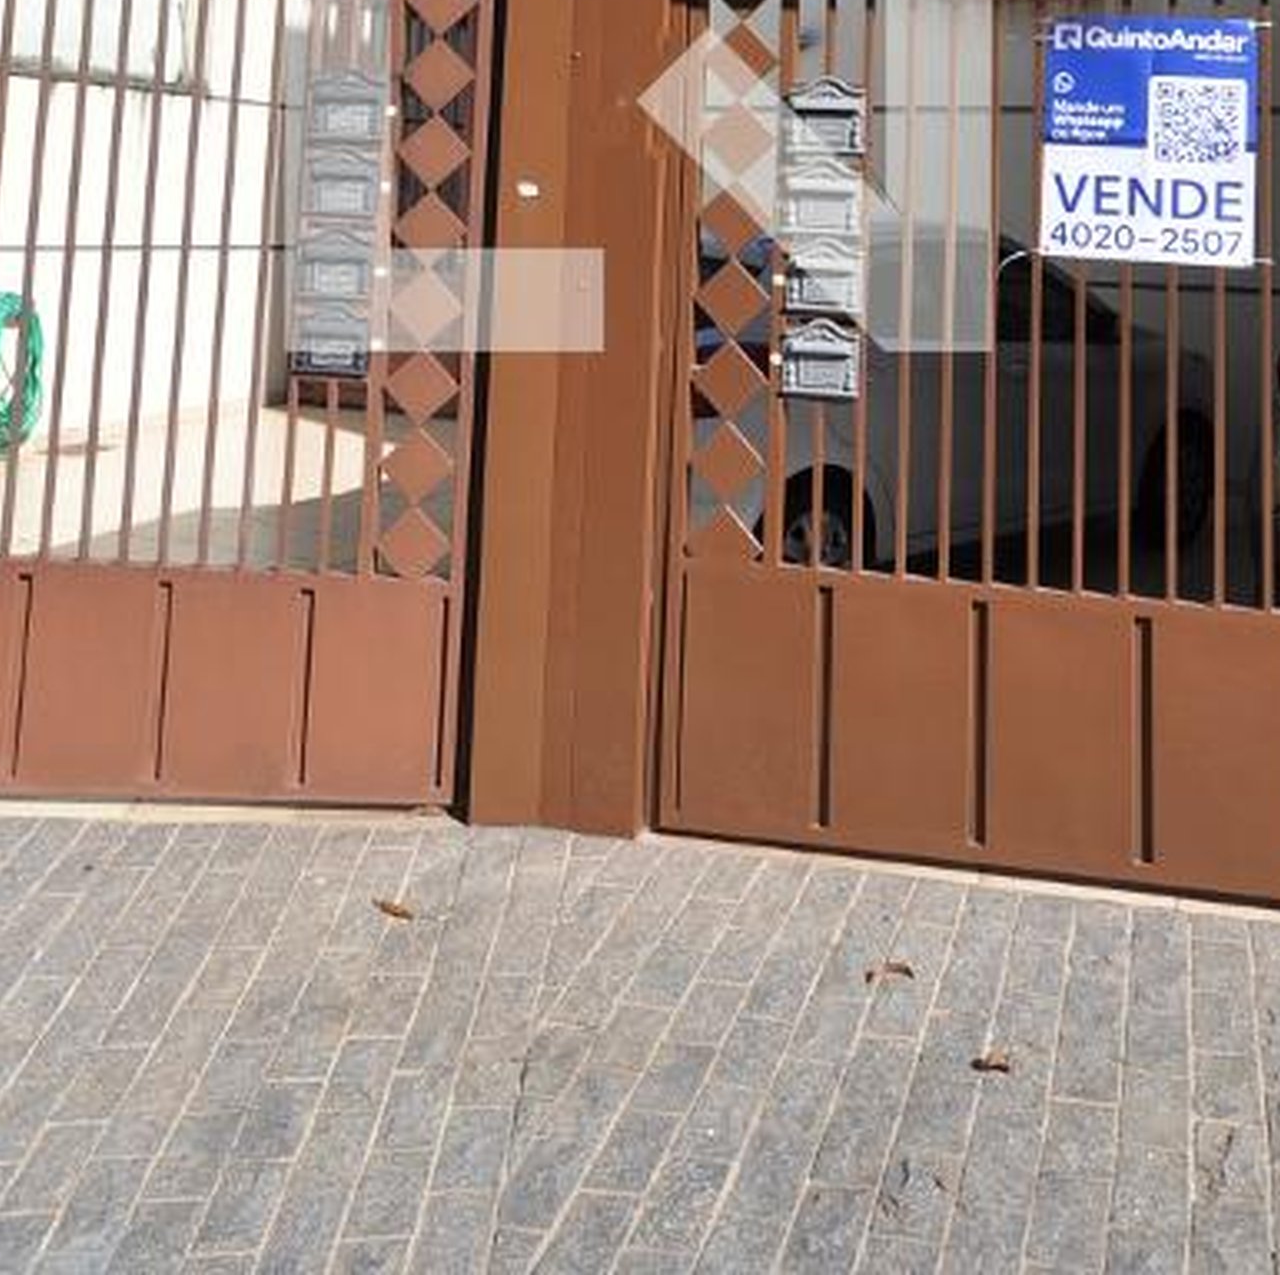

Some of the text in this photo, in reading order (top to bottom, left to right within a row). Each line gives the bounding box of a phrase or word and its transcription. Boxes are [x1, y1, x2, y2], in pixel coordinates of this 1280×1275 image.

[1085, 26, 1248, 53] QuintoAndar
[1053, 174, 1244, 223] VENDE
[1050, 222, 1244, 256] 4020-2507
